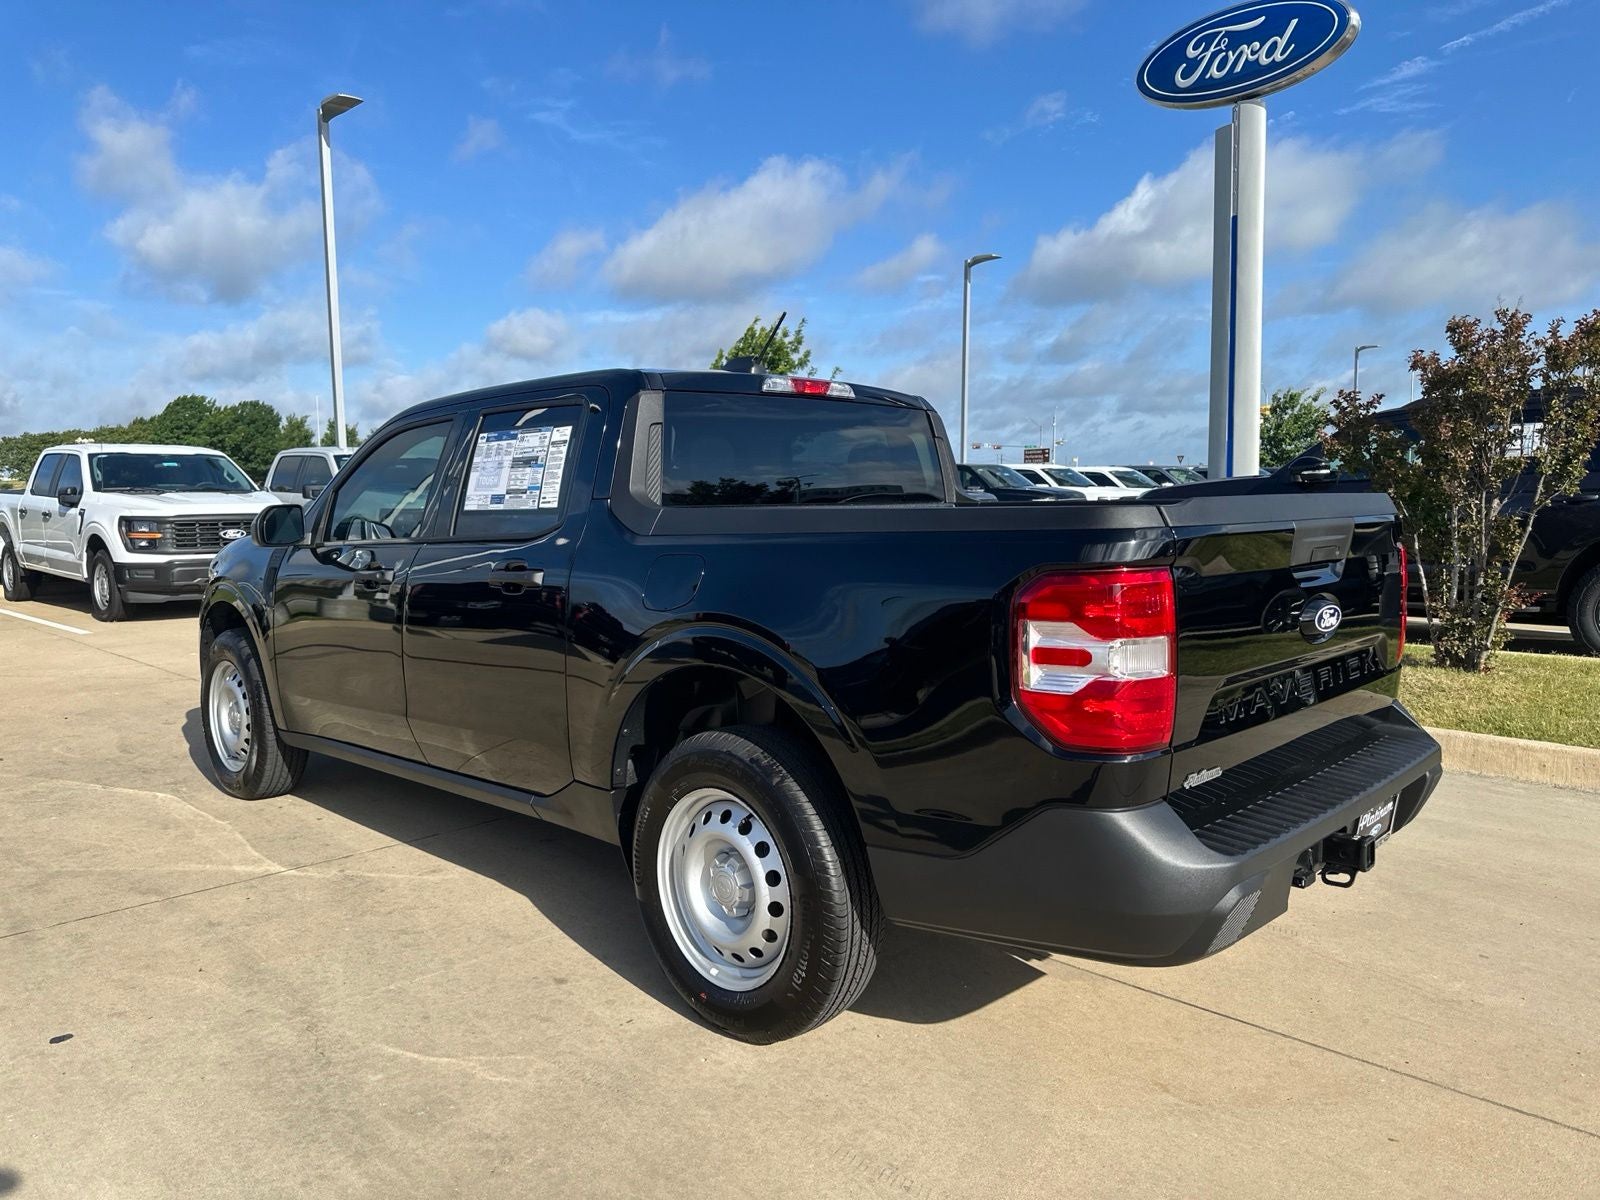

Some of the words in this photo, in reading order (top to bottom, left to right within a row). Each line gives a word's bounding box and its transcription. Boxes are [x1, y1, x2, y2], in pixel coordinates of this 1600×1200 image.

[1175, 16, 1298, 88] Ford
[1321, 608, 1339, 631] Ford
[1217, 646, 1381, 725] MAVERICK
